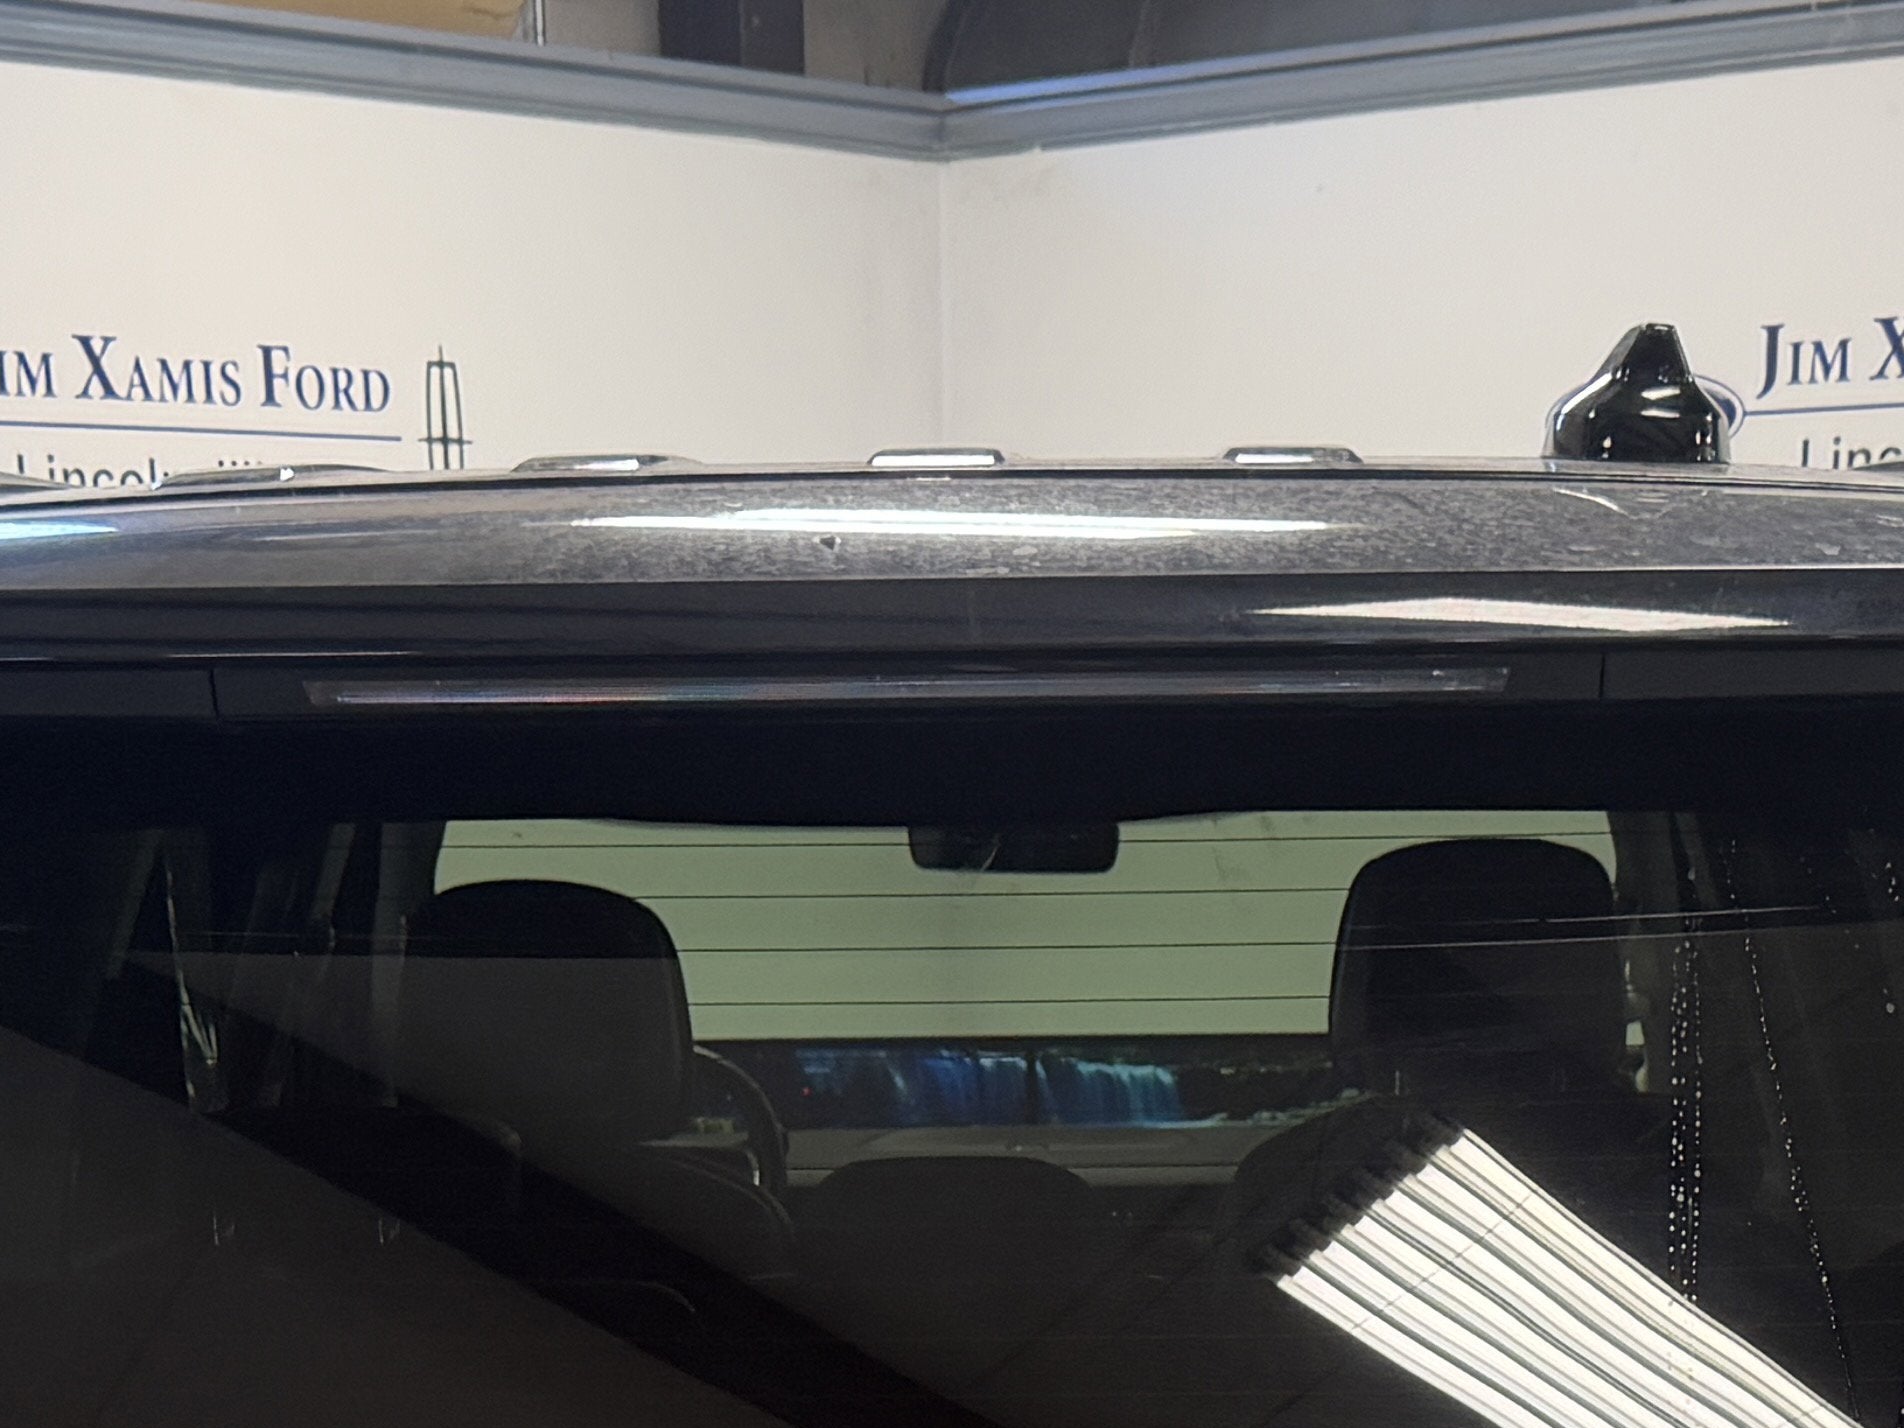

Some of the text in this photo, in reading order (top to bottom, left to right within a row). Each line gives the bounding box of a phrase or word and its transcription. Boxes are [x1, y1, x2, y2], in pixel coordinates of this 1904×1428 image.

[71, 334, 243, 407] XAMIS
[257, 344, 391, 412] FORD
[1756, 324, 1851, 399] JIM
